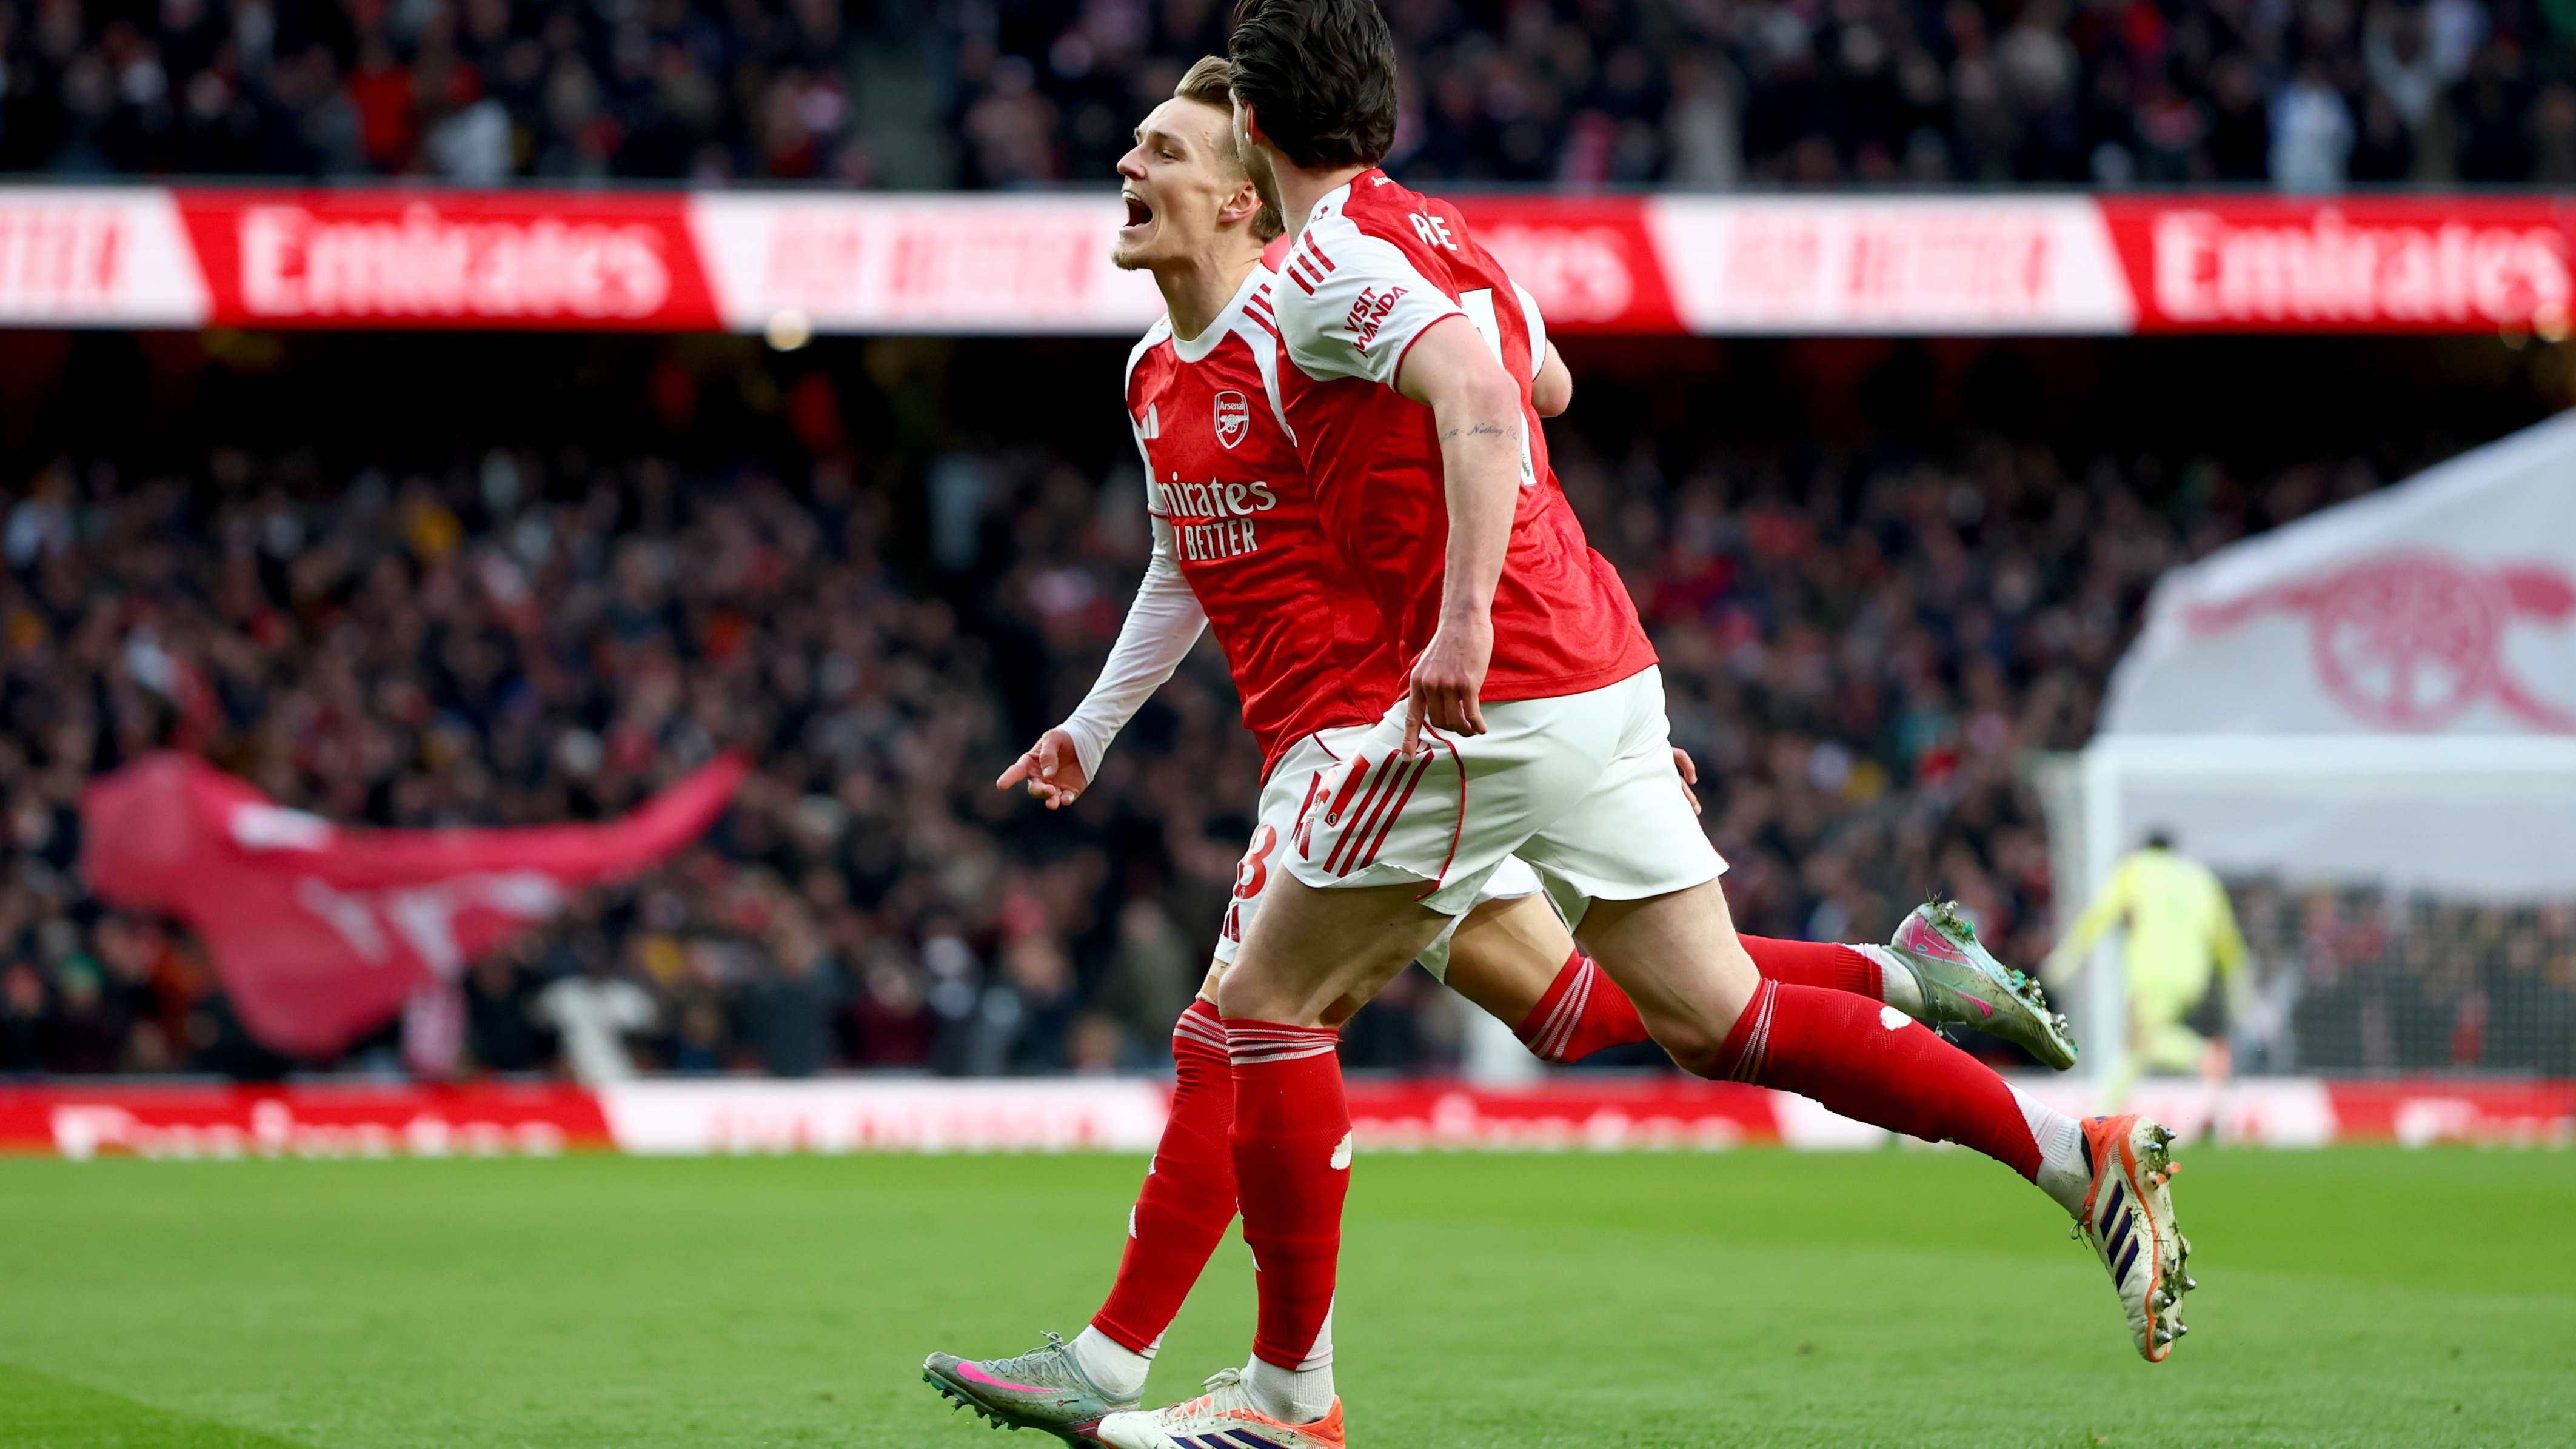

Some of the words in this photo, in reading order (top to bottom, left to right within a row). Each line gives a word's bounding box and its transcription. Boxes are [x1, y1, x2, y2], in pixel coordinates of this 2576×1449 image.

[1344, 286, 1376, 332] VISIT
[1219, 401, 1245, 410] Arsenal
[1185, 518, 1259, 560] BETTER
